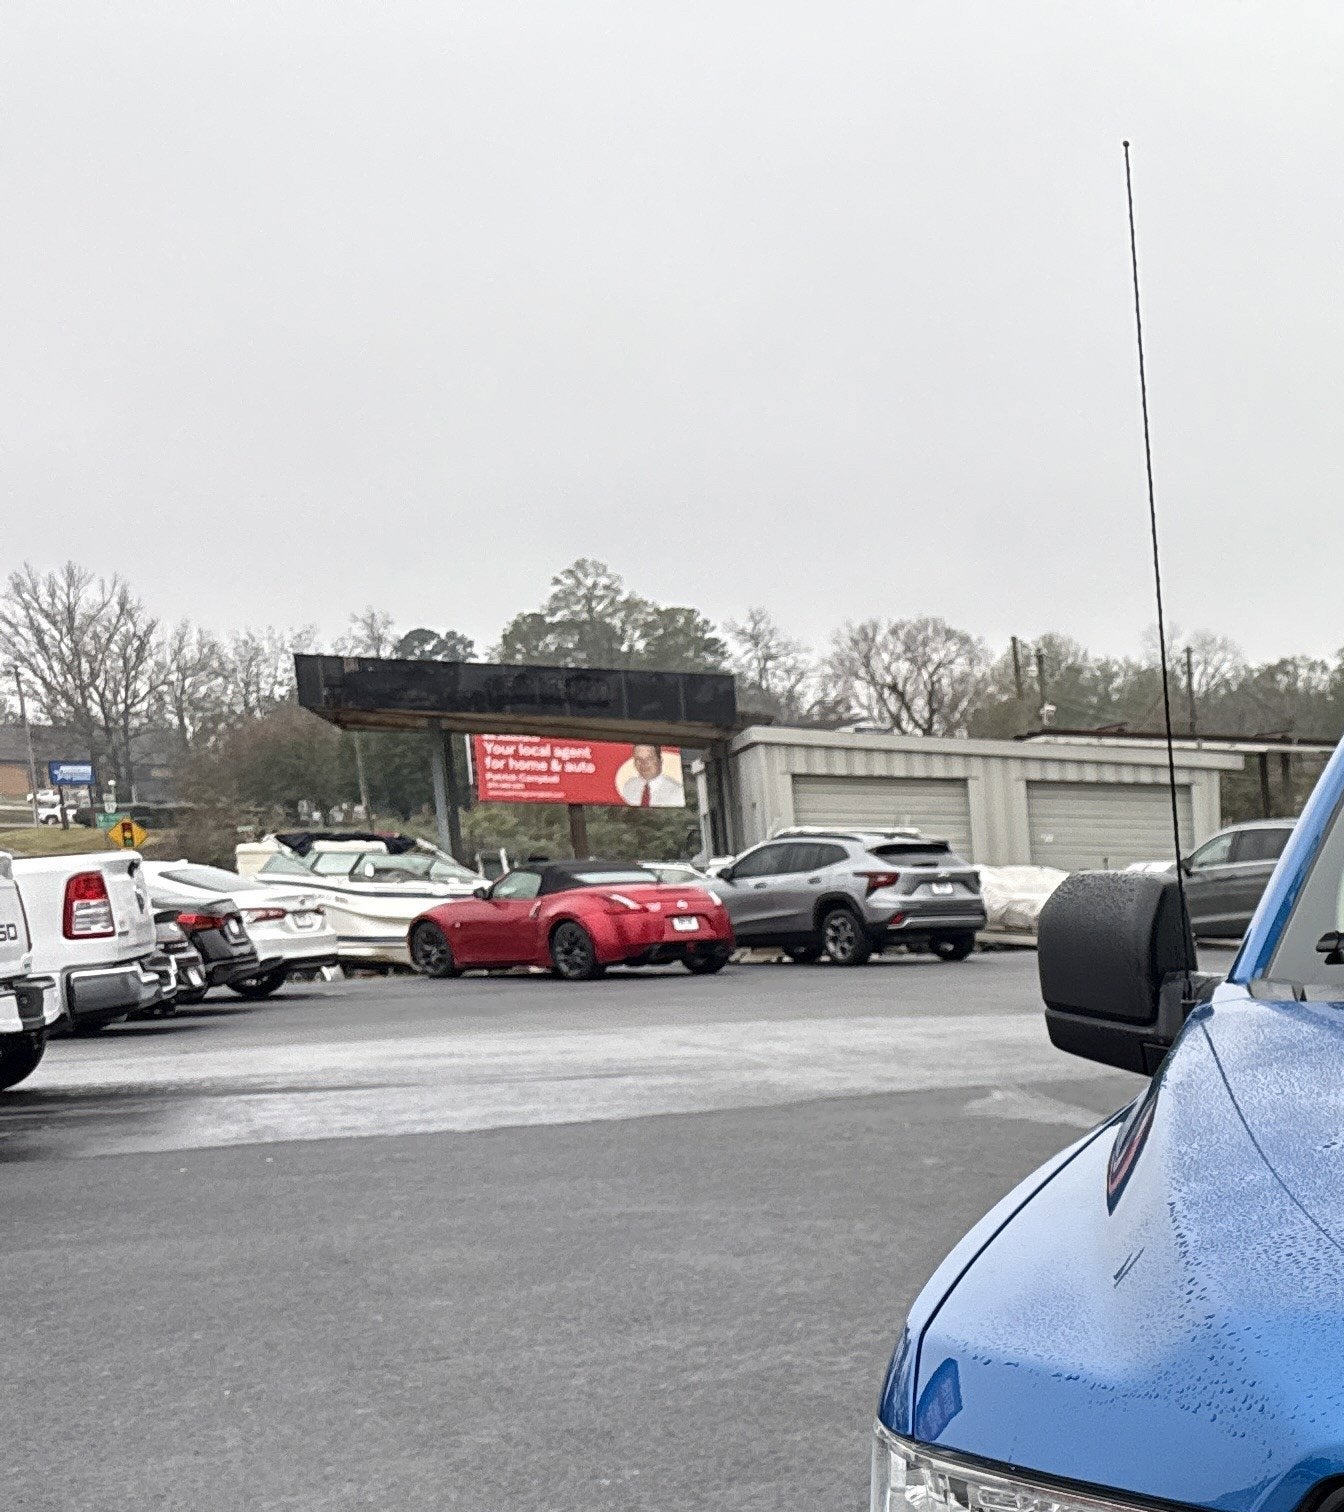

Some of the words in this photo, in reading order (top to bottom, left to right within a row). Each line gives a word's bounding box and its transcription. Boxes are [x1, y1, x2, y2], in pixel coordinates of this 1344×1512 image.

[483, 741, 516, 755] Your
[518, 743, 551, 757] local
[553, 746, 592, 760] agent
[484, 756, 506, 770] for
[508, 756, 548, 772] home
[550, 758, 562, 773] &
[564, 761, 596, 773] auto
